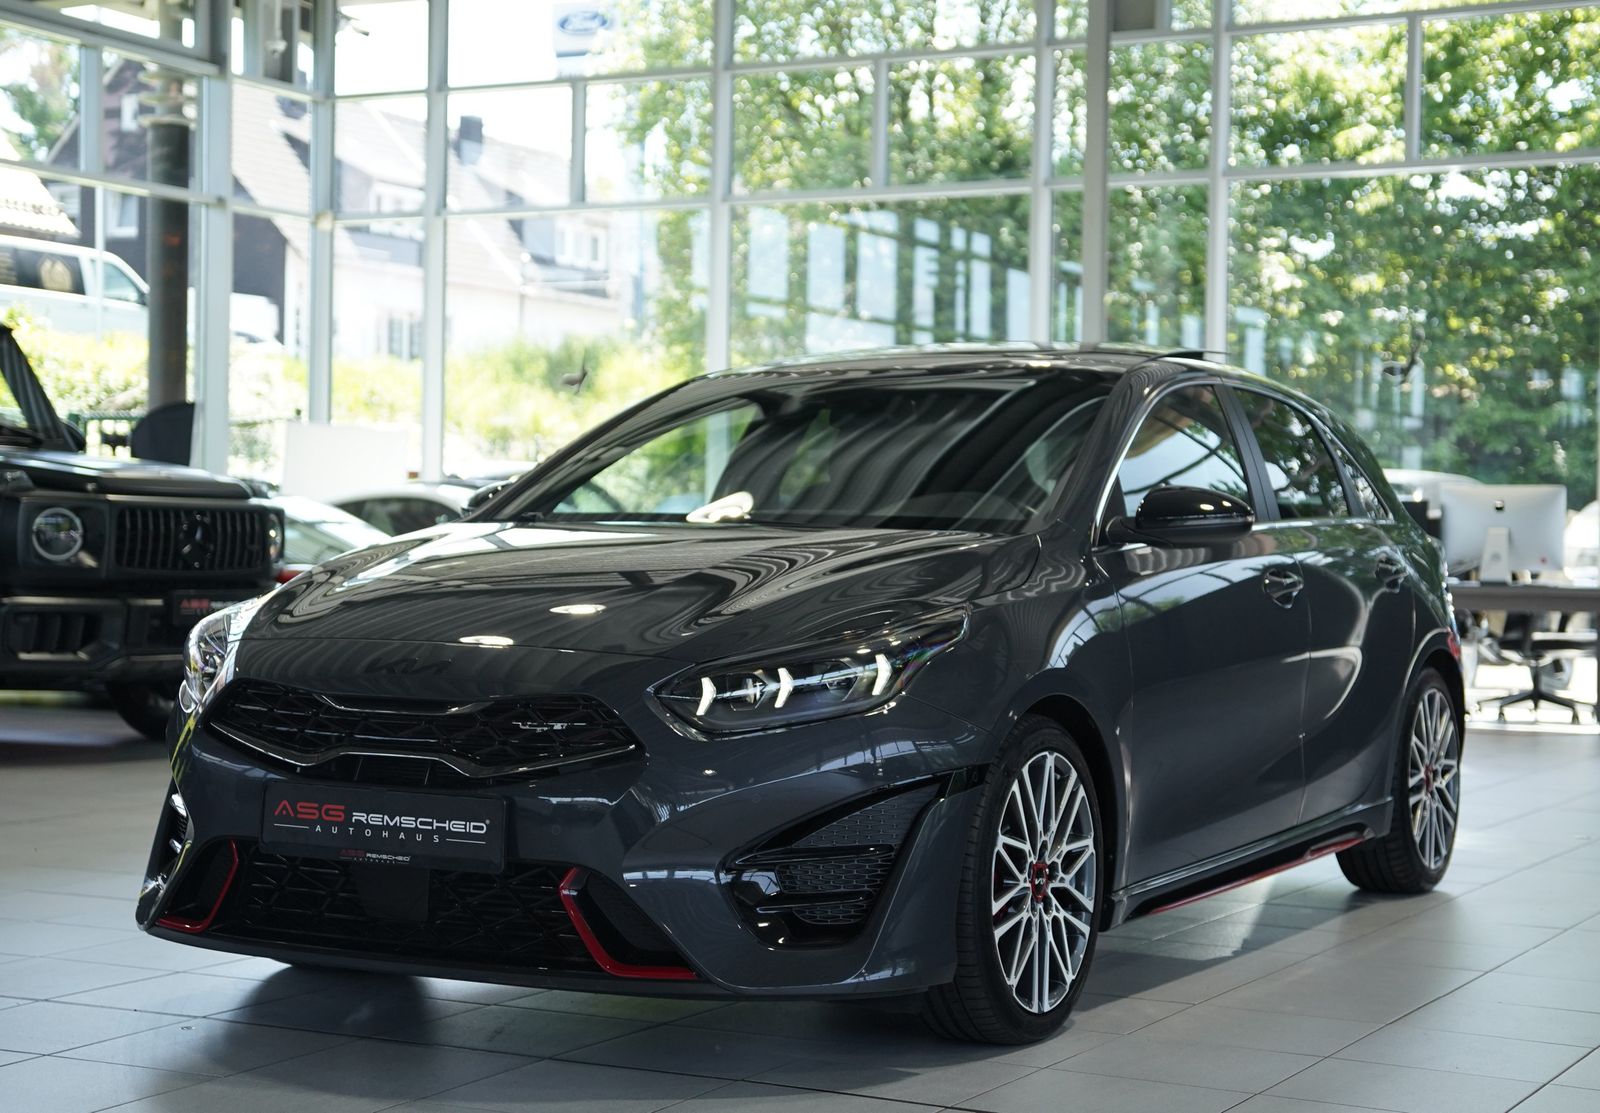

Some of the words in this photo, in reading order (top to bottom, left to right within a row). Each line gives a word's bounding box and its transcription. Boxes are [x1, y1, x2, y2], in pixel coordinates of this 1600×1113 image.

[274, 800, 345, 822] ASG
[352, 812, 487, 834] REMSCHEID
[315, 825, 440, 843] AUTOHAUS
